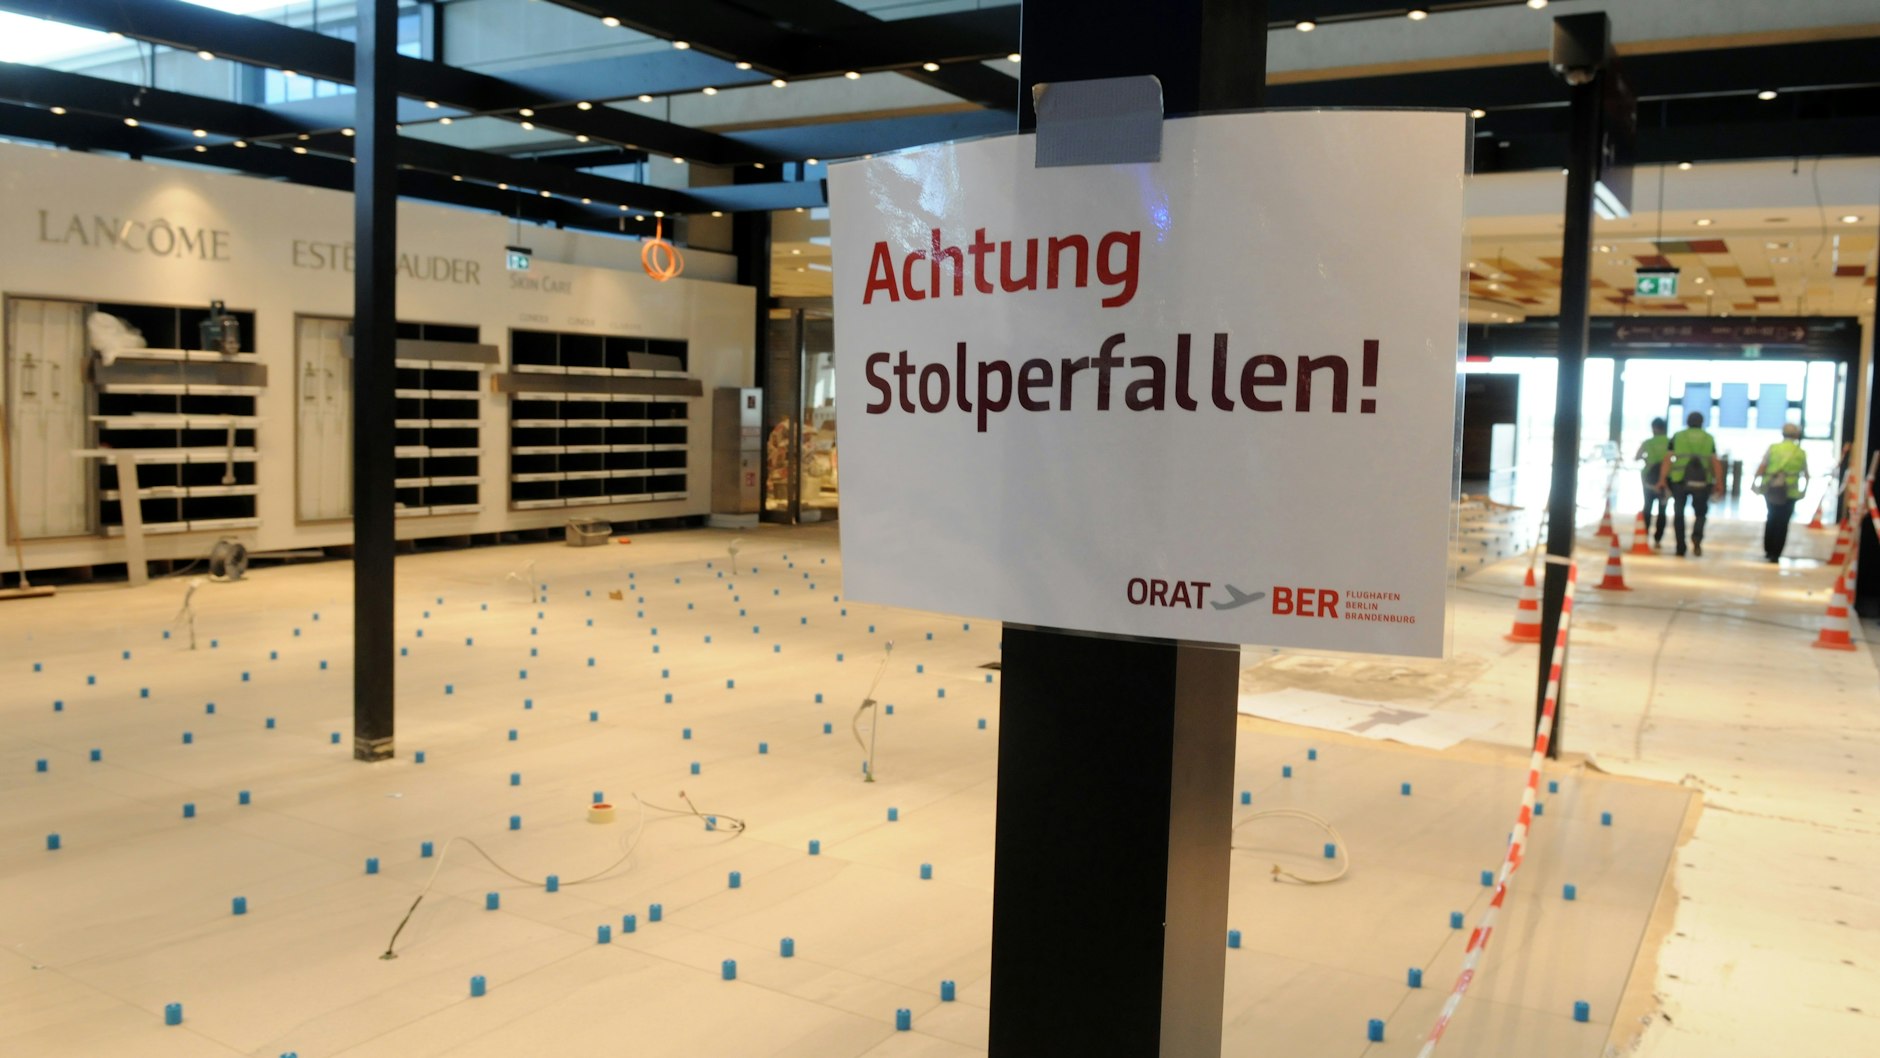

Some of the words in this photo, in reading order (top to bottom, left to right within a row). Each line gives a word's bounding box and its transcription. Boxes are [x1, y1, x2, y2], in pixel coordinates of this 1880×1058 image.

[38, 209, 230, 261] LANCÔME
[396, 252, 481, 286] AUDER
[862, 227, 1142, 309] Achtung
[865, 332, 1380, 433] Stolperfallen!
[1126, 577, 1212, 610] ORAT
[1271, 586, 1340, 619] BER
[1345, 601, 1378, 611] BERLIN
[1346, 590, 1401, 601] FLUGHAFEN
[1345, 612, 1417, 625] BRANDENBURG
